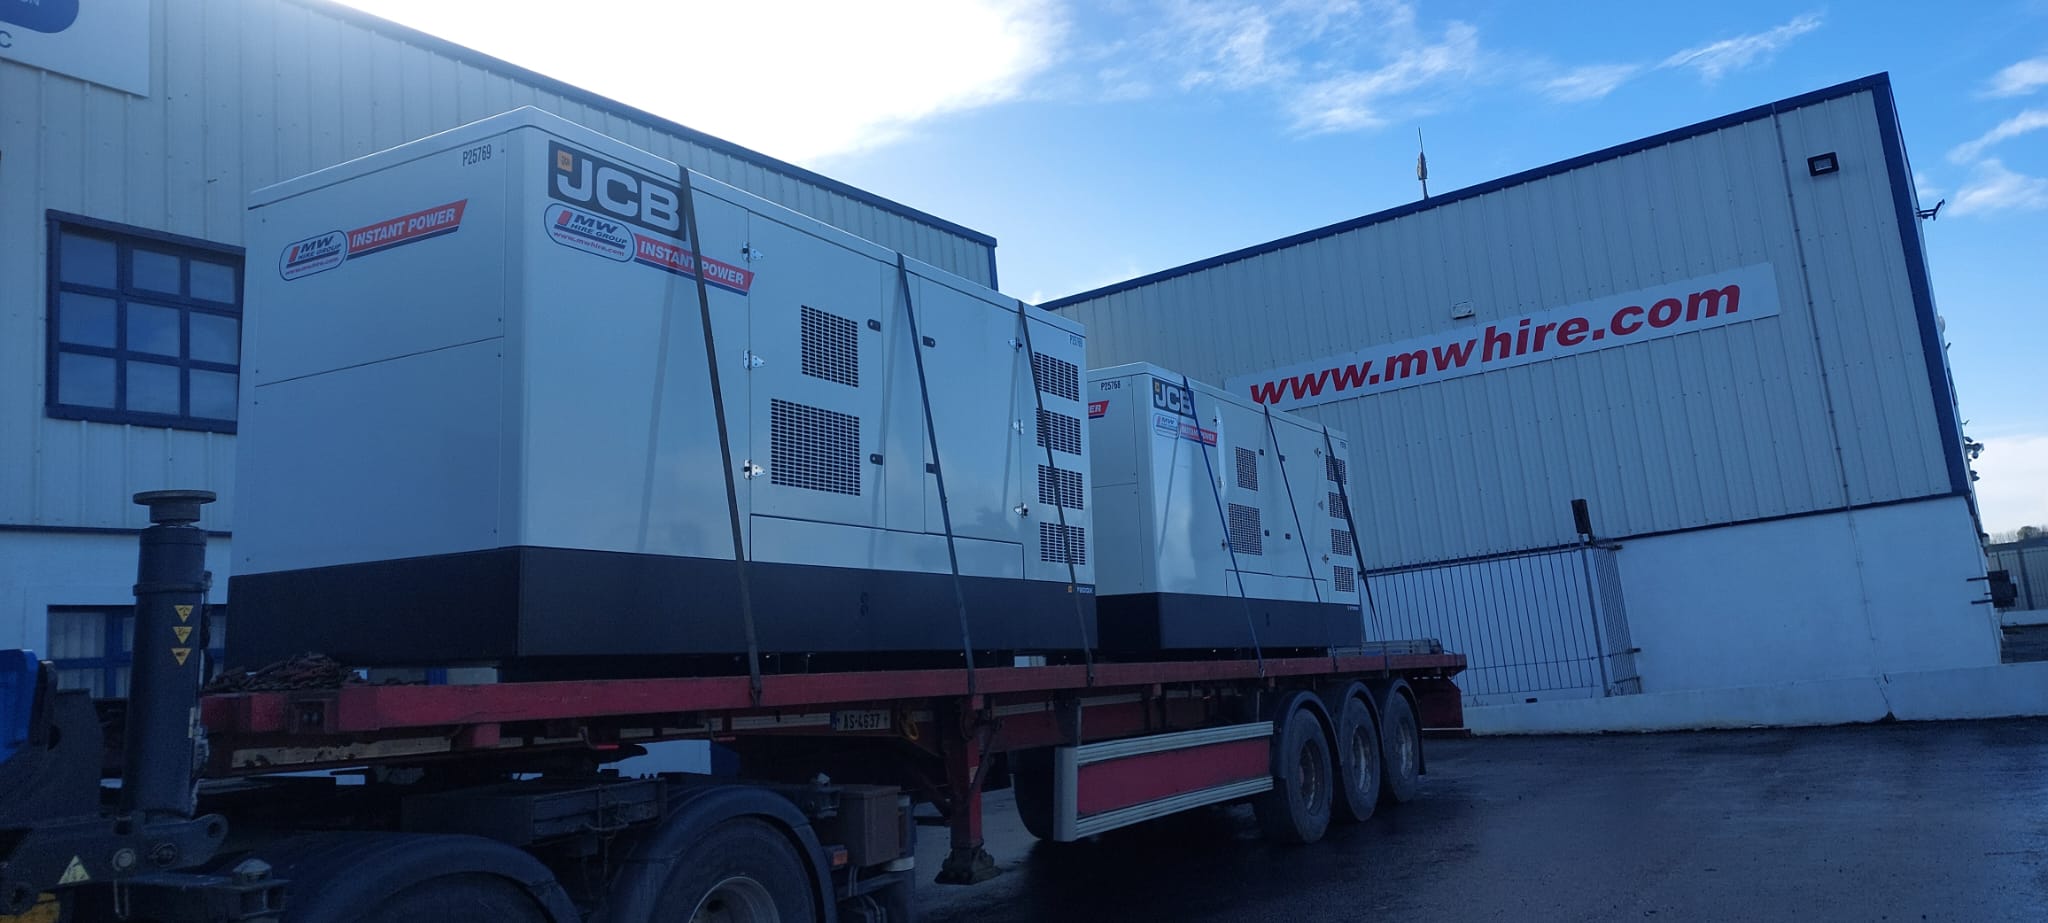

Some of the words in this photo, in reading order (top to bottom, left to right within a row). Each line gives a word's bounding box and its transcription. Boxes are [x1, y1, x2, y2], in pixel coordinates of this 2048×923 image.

[463, 144, 492, 167] P25769
[557, 158, 680, 232] JCB
[352, 221, 406, 248] INSTANT
[407, 207, 456, 233] POWER
[570, 223, 593, 235] HIRE
[596, 230, 627, 245] GROUP
[574, 214, 618, 234] MW
[301, 236, 334, 253] MW
[640, 240, 696, 271] INSTANT
[702, 261, 745, 286] POWER
[1249, 283, 1742, 405] www.mwhire.com
